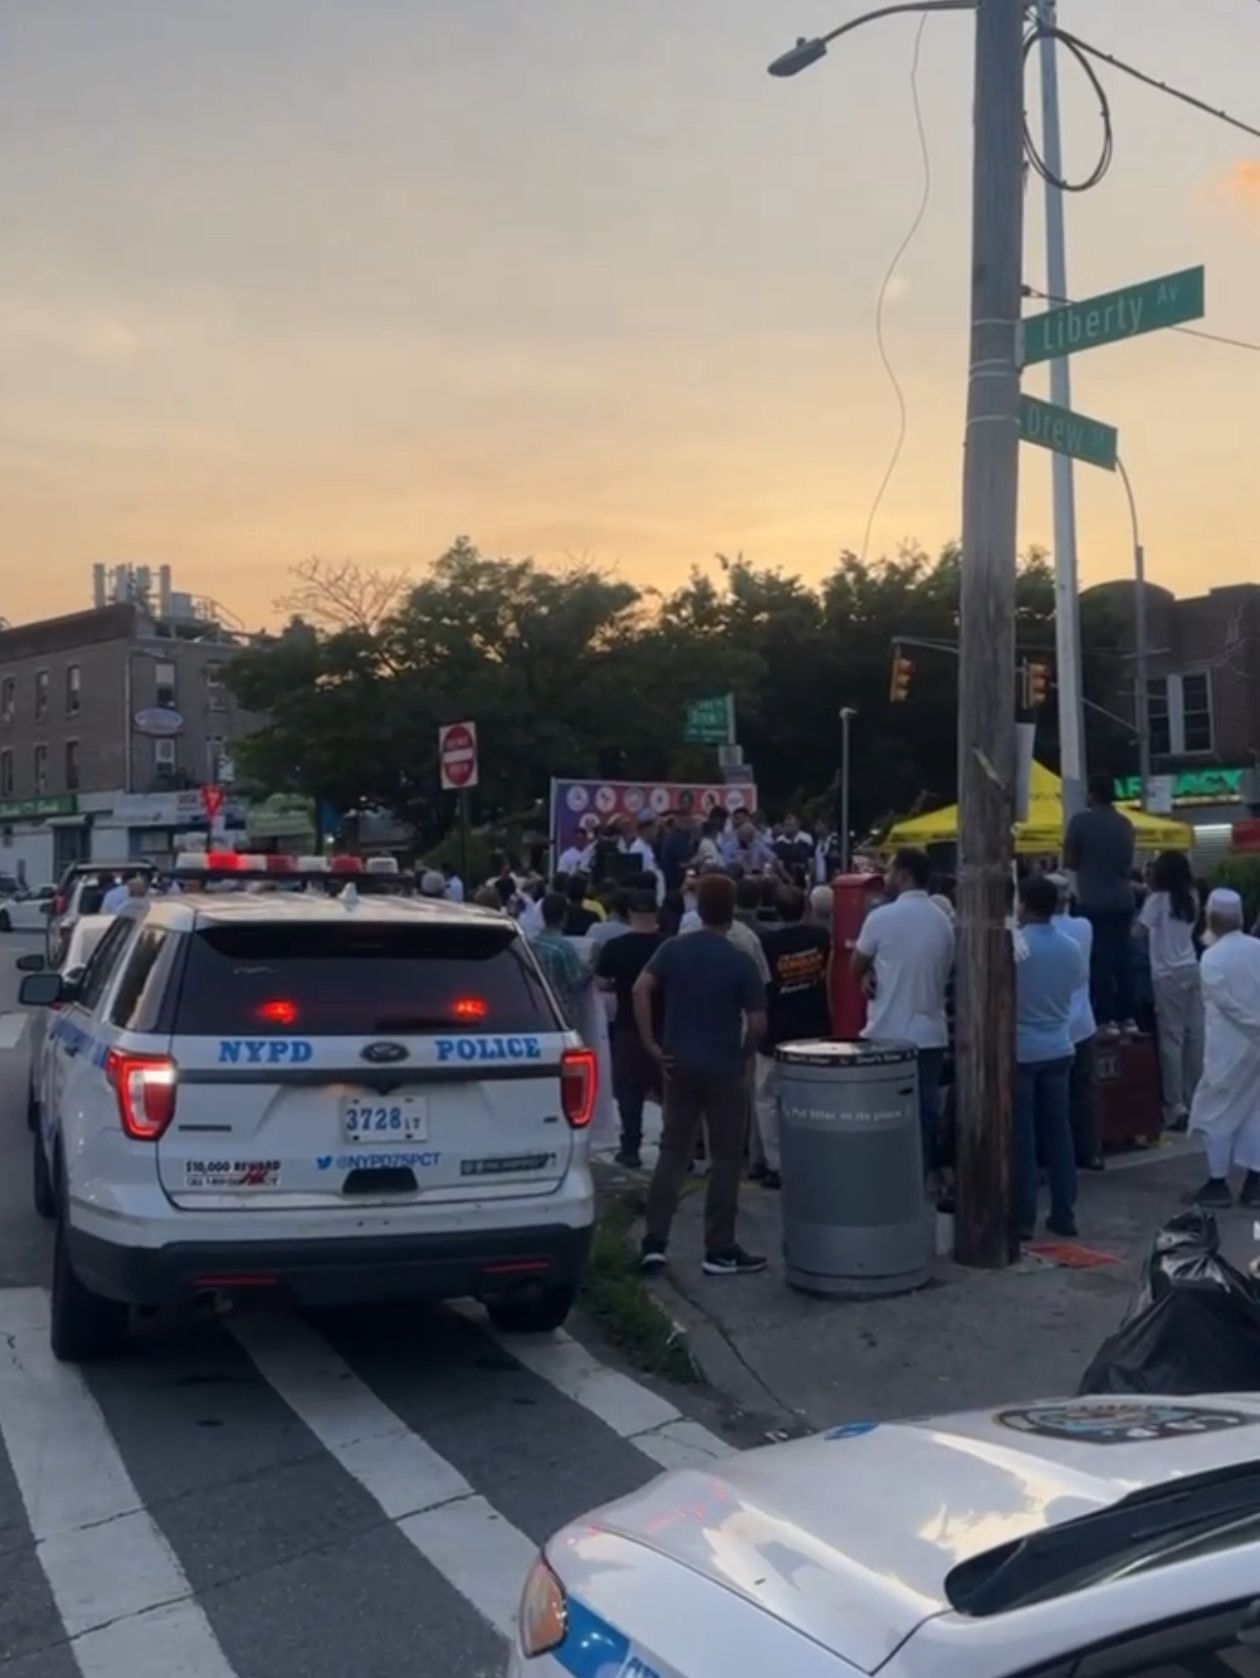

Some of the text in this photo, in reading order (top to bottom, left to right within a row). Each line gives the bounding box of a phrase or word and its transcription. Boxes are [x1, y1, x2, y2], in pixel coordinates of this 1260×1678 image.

[1043, 282, 1180, 351] Liberty Av
[1027, 404, 1084, 452] Drew
[218, 1039, 313, 1064] NYPD
[433, 1036, 542, 1062] POLICE
[345, 1106, 421, 1131] 3728 17
